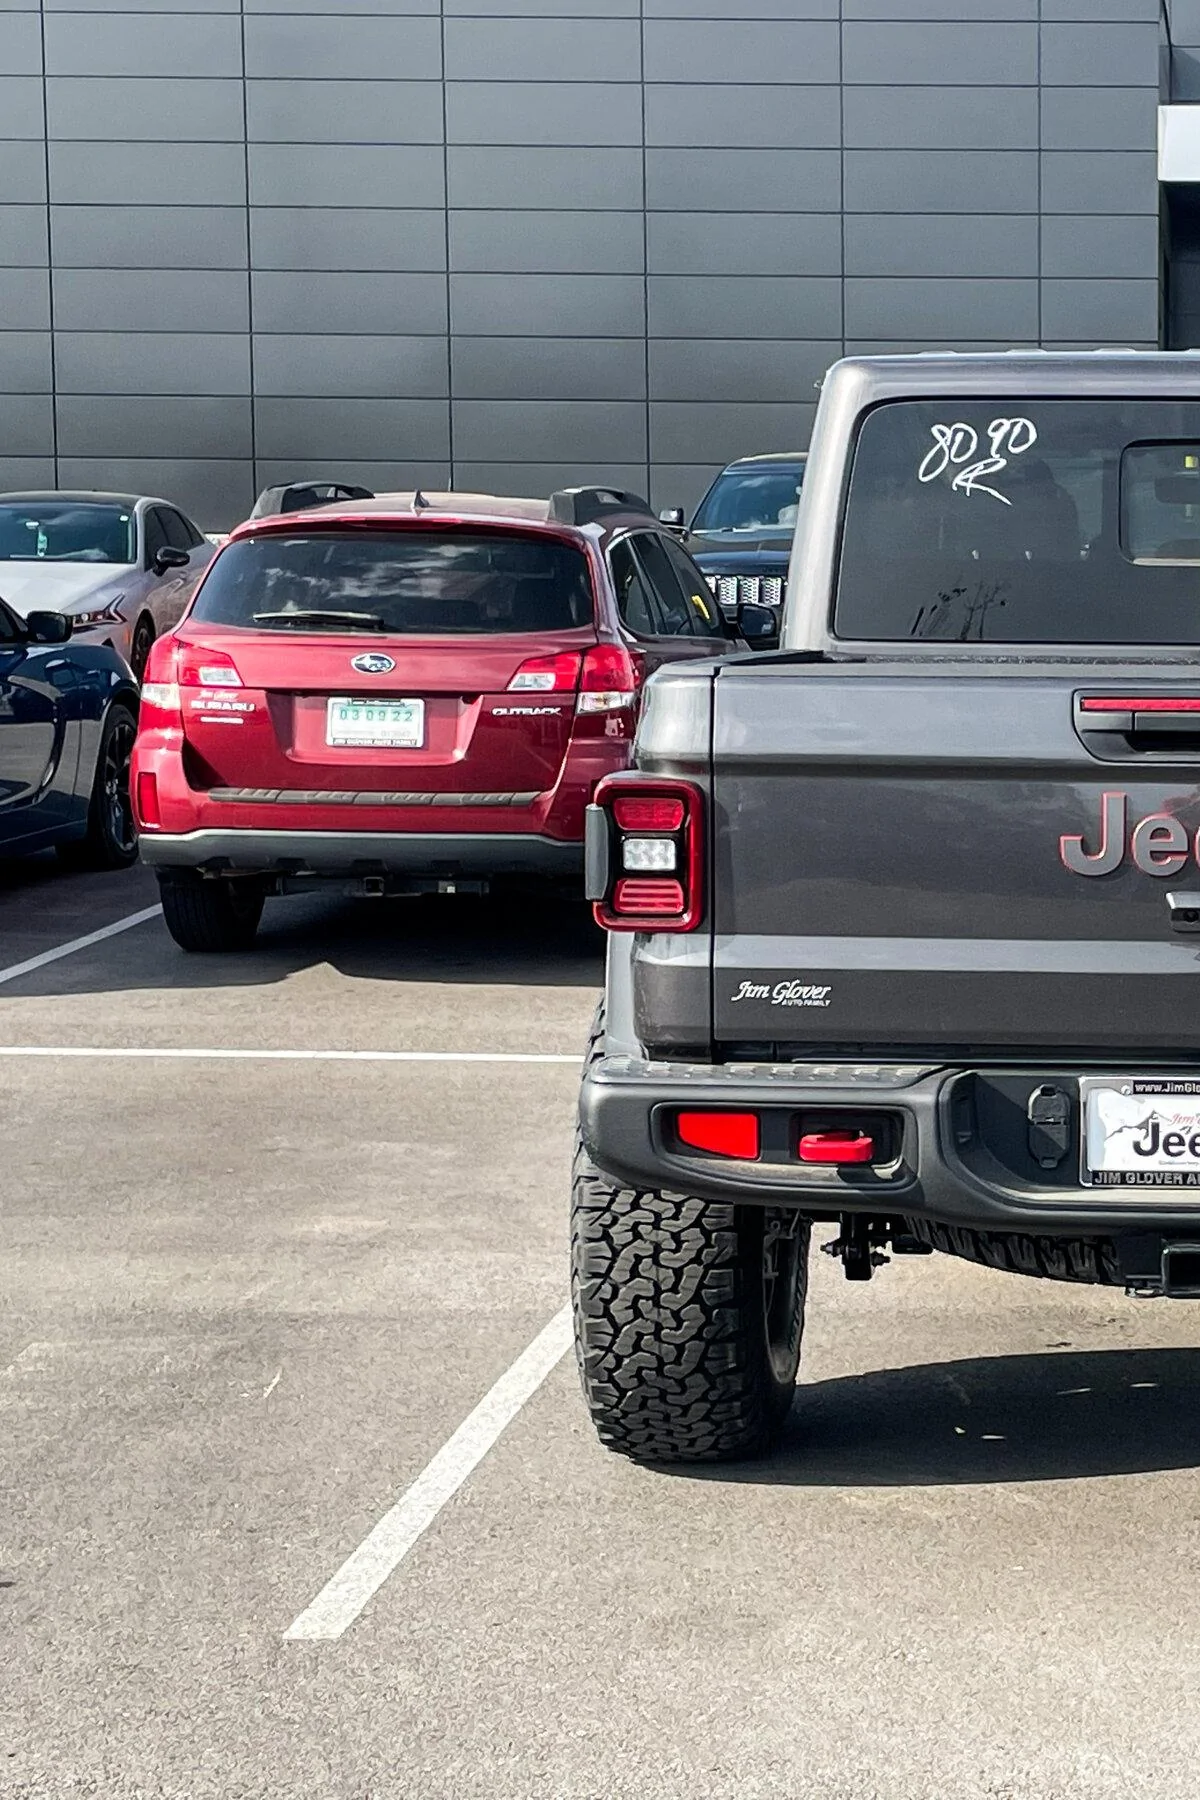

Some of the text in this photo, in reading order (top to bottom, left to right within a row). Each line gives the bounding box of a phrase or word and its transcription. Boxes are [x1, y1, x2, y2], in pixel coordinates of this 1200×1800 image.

[731, 979, 831, 1004] Jim Glover
[1095, 1171, 1121, 1184] JIM
[1125, 1172, 1184, 1185] GLOVER
